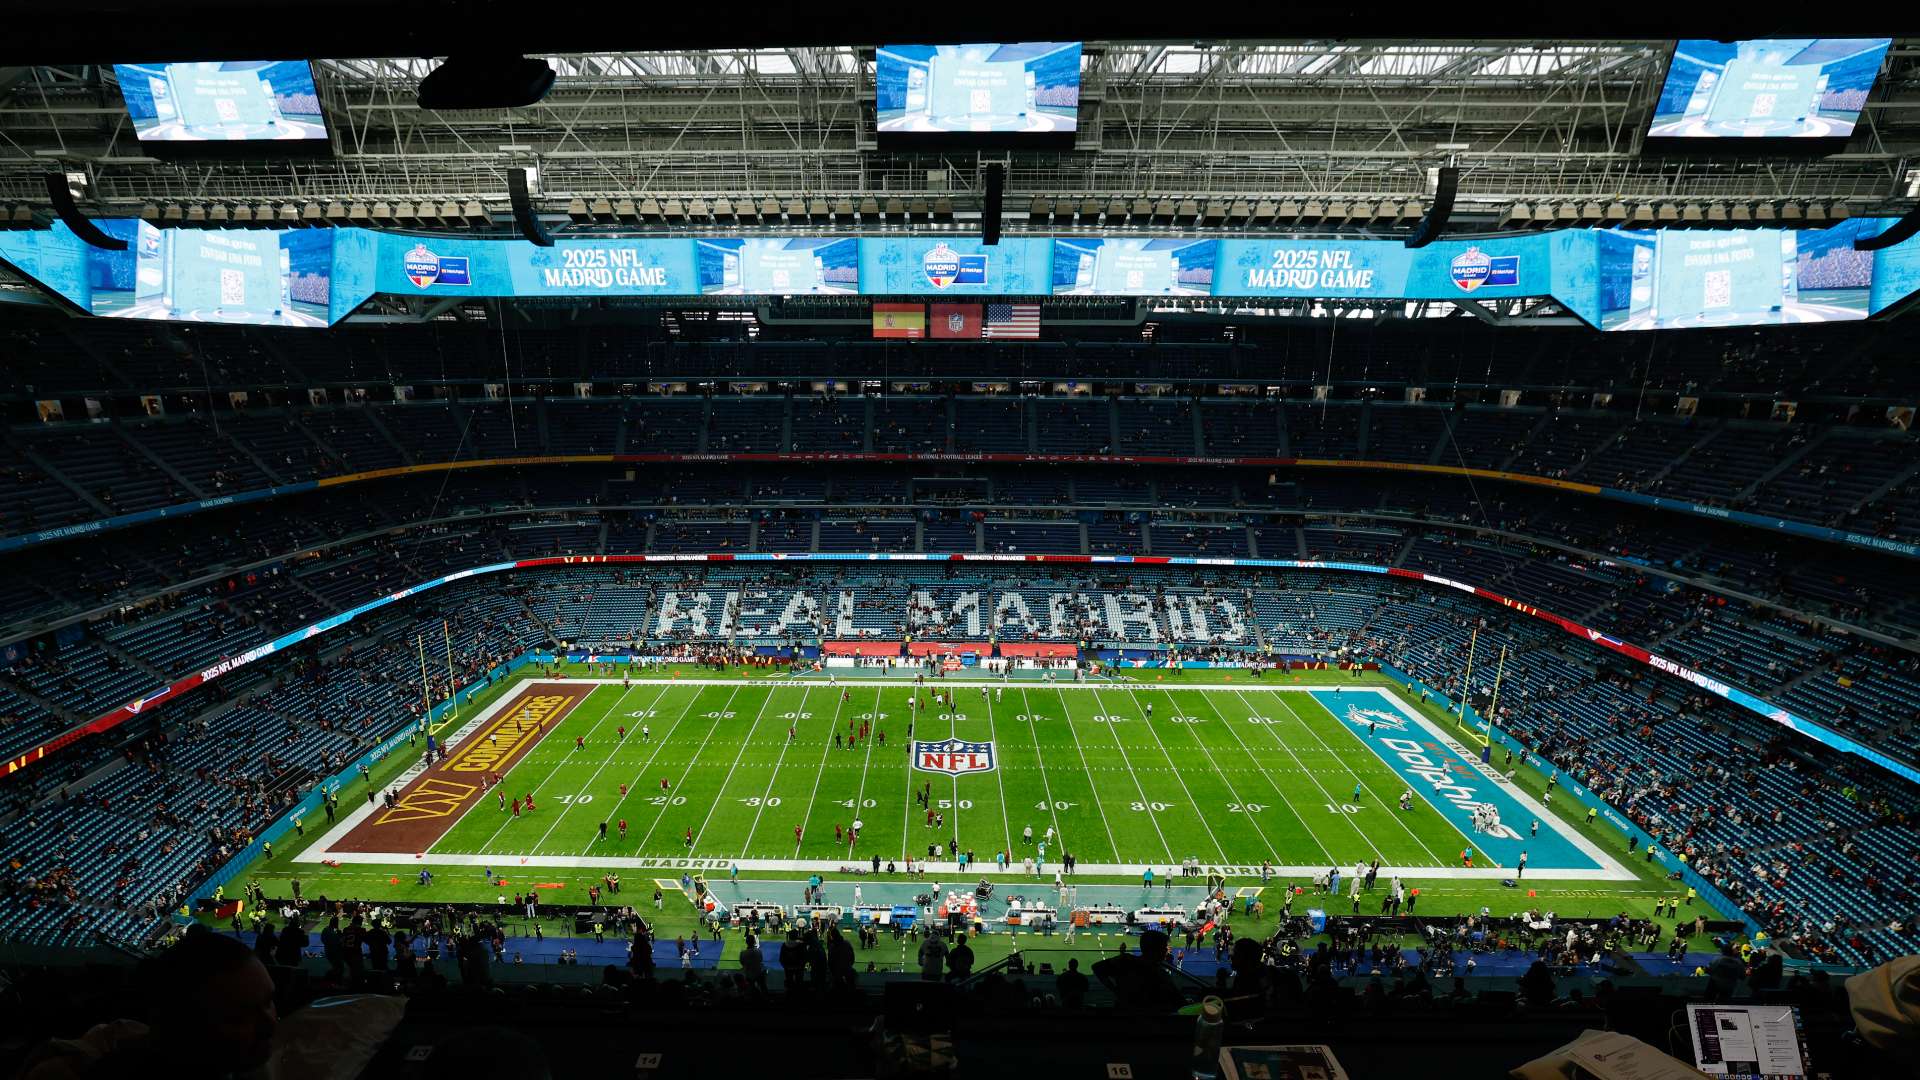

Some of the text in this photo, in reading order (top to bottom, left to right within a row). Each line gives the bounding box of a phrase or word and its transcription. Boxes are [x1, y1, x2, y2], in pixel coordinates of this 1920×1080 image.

[562, 249, 643, 268] 2025 NFL
[1272, 250, 1353, 269] 2025 NFL
[406, 264, 437, 272] MADRID
[926, 264, 957, 272] MADRID
[544, 267, 666, 287] MADRID GAME
[1248, 270, 1373, 289] MADRID GAME
[655, 591, 1246, 641] REAL MADRID
[201, 642, 275, 682] 2025 NFL MADRID GAME
[1648, 655, 1729, 697] 2025 NFL MADRID GAME
[631, 710, 658, 718] 10
[707, 711, 737, 719] 20
[1093, 715, 1122, 723] 30
[1171, 716, 1201, 724] 20
[453, 695, 565, 772] COMMANDERS
[922, 753, 987, 771] NFL
[1379, 737, 1524, 841] Dolphis
[558, 794, 593, 805] 10
[650, 796, 687, 806] 20
[745, 797, 782, 807] 30
[842, 798, 878, 808] 40
[938, 799, 973, 809] 50
[1035, 800, 1070, 810] 40
[1130, 801, 1167, 812] 30
[1227, 802, 1265, 813] 20
[1325, 803, 1359, 814] 10
[641, 858, 730, 869] MADRID
[1111, 1066, 1129, 1076] 16
